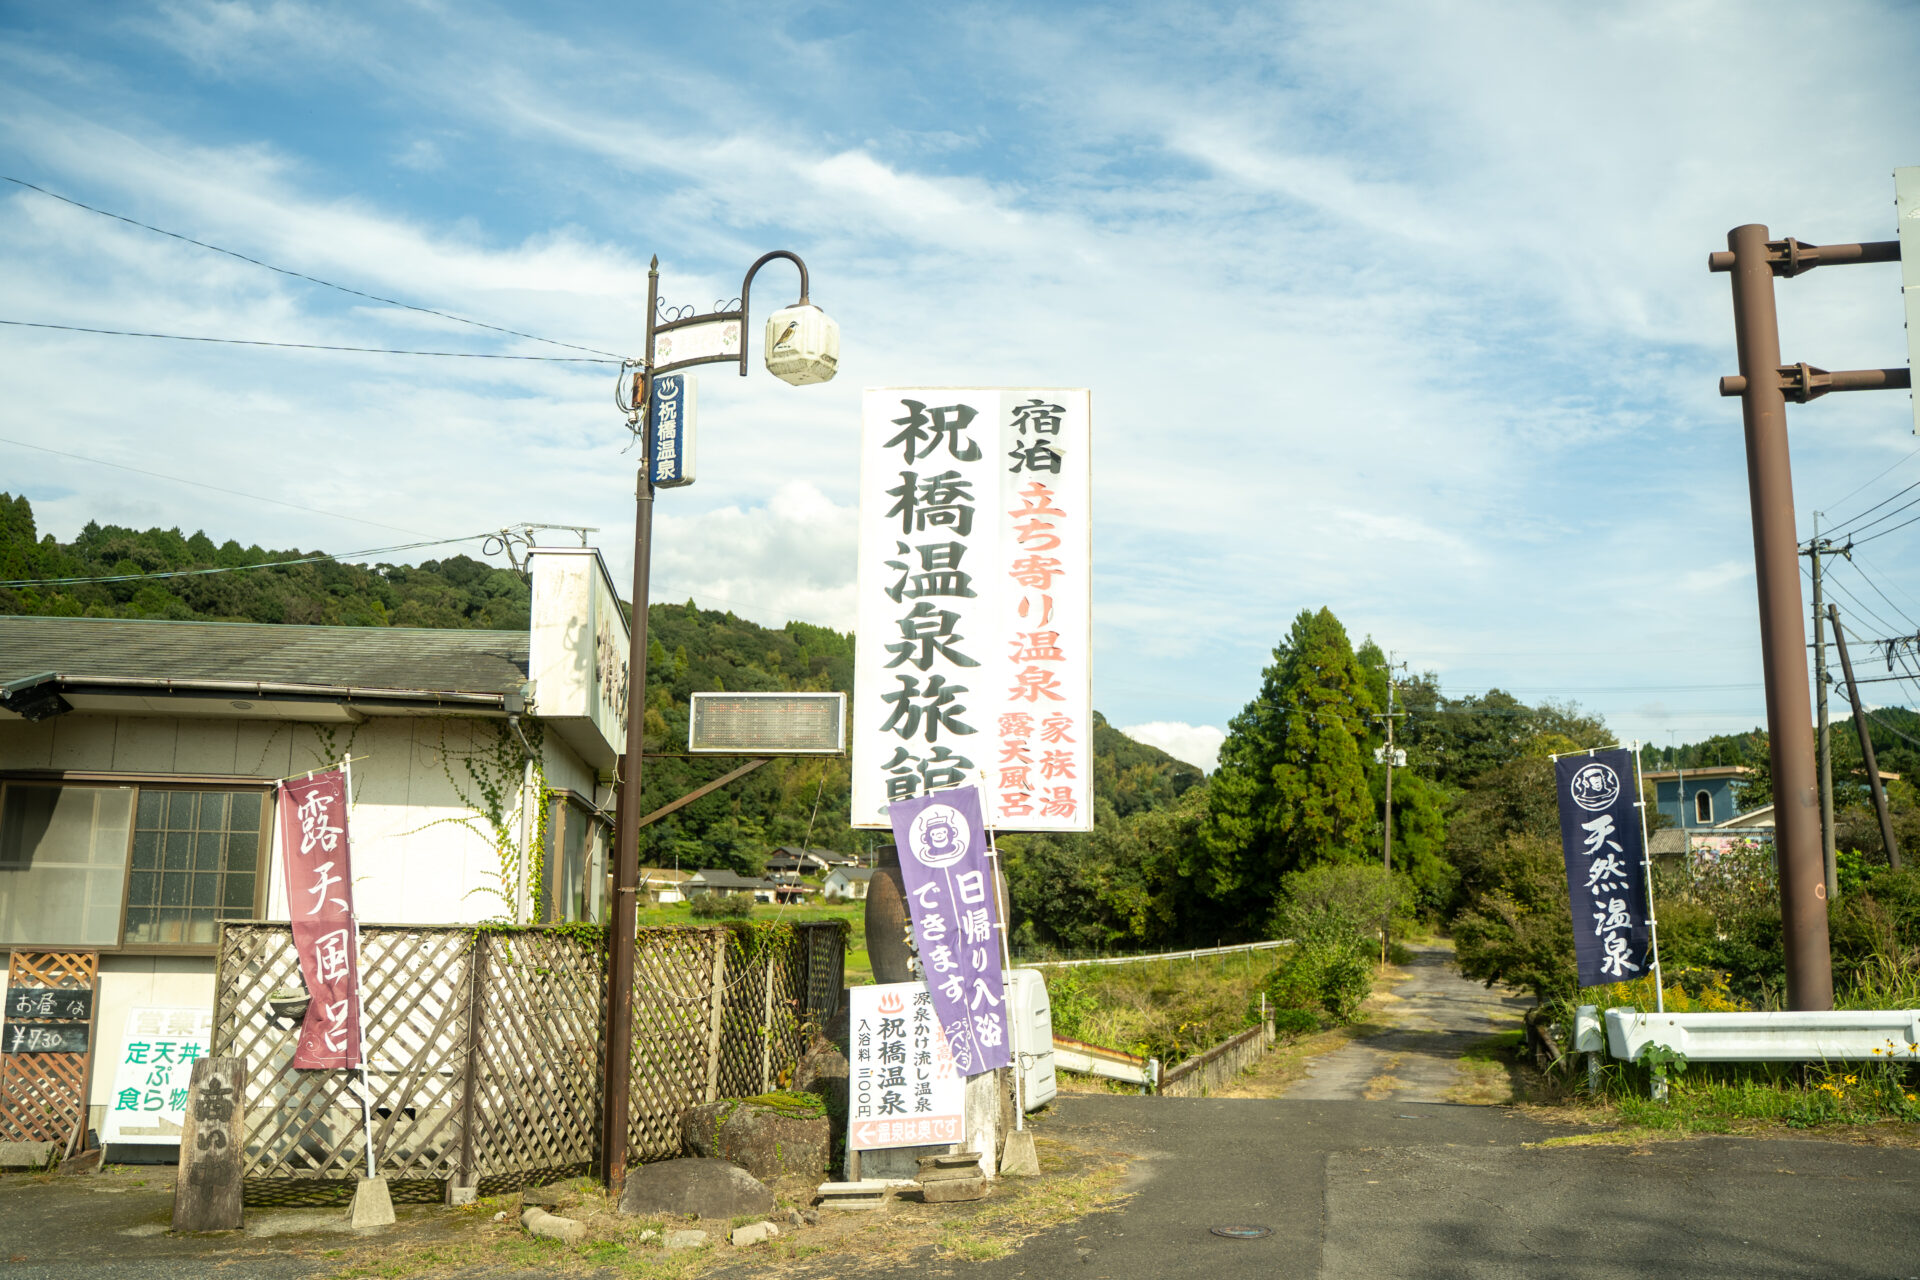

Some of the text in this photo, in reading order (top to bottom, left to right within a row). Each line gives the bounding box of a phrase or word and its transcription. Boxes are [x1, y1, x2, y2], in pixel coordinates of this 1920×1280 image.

[655, 400, 678, 481] 祝橋温泉
[1008, 398, 1067, 475] 宿泊
[1007, 481, 1067, 703] 立ち寄り温泉
[997, 711, 1035, 818] 露天風呂
[1038, 711, 1078, 818] 家族湯
[297, 789, 349, 1053] 露天風呂
[1581, 814, 1639, 977] 天然温泉
[955, 869, 1003, 1048] 日帰り入浴
[876, 1017, 908, 1116] 祝橋温泉
[912, 991, 933, 1113] 源泉かけ流し温泉
[877, 1118, 958, 1144] 温泉は奥です
